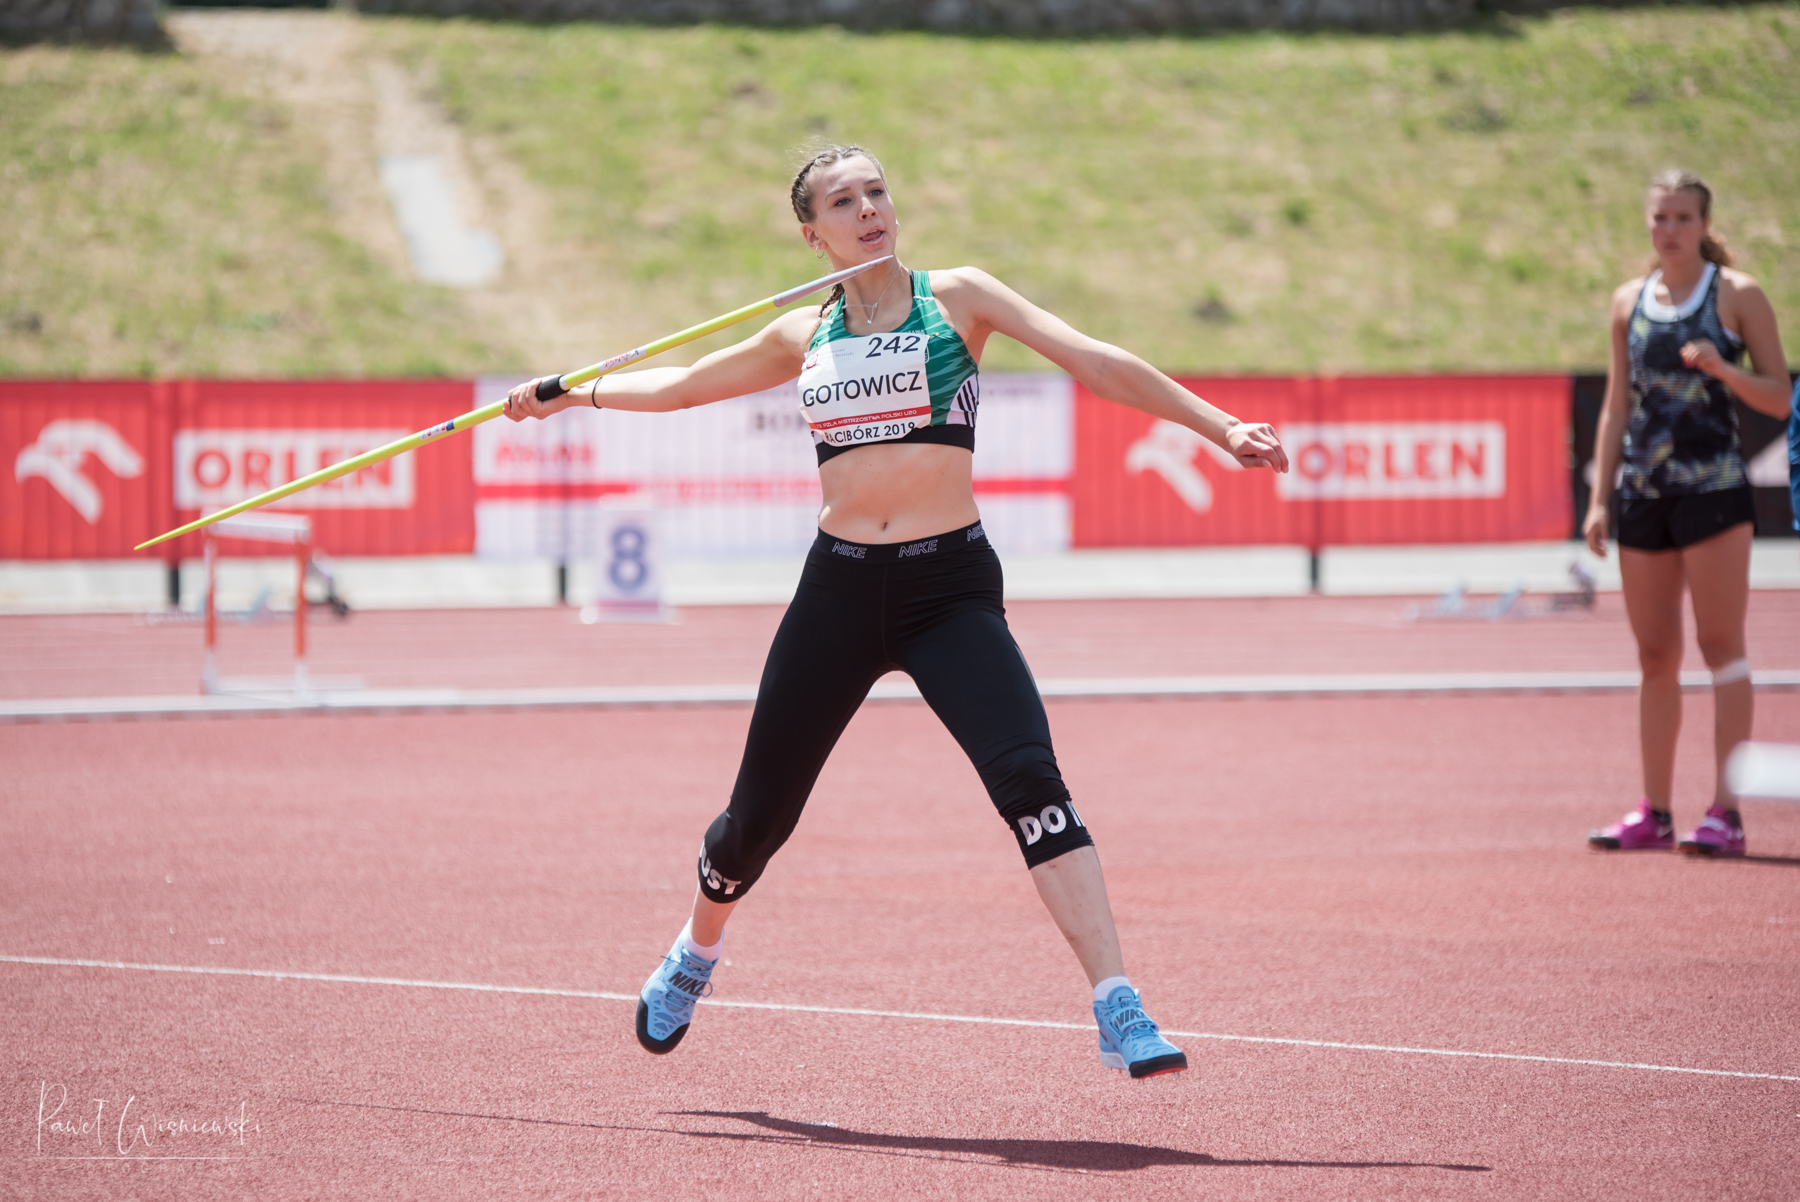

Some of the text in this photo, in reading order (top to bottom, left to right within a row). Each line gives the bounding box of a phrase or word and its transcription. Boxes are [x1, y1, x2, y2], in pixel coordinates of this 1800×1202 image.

[865, 335, 921, 359] 242
[802, 370, 923, 407] GOTOWICZ
[824, 421, 916, 444] RACIBÓRZ 2019
[881, 411, 903, 419] POLSKI
[193, 449, 392, 490] ORLEN
[1297, 442, 1483, 481] ORLEN
[609, 525, 649, 591] 8
[832, 541, 867, 559] NIKE
[898, 539, 939, 558] NIKE
[1017, 801, 1085, 846] DO I
